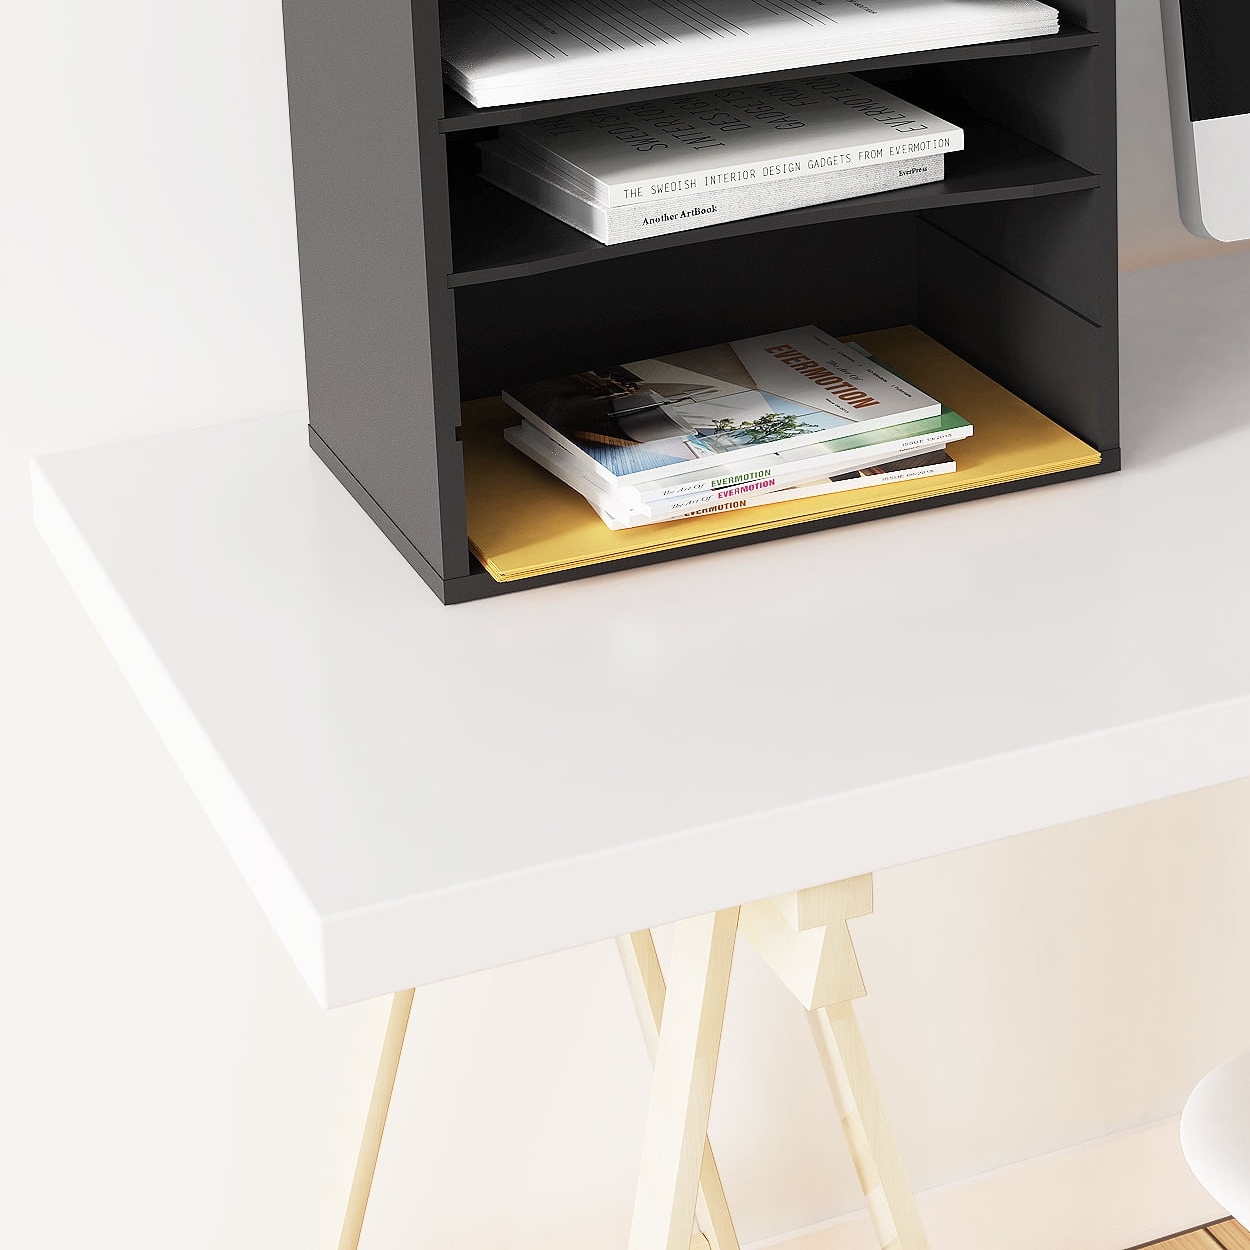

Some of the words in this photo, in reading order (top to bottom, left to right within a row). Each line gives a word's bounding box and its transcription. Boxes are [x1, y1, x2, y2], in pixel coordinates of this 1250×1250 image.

[714, 89, 805, 131] GADGETS
[623, 186, 644, 199] THE
[650, 178, 697, 195] SWEDISH
[704, 168, 756, 187] INTERIOR
[762, 161, 801, 177] DESIGN
[807, 153, 852, 170] GADGETS
[858, 148, 883, 162] FROM
[889, 137, 951, 156] EVERMOTION
[642, 211, 679, 226] Another
[679, 204, 718, 219] ArtBook
[763, 343, 881, 410] EVERMOTION
[711, 469, 771, 488] EVERMOTION
[717, 478, 776, 499] EVERMOTION
